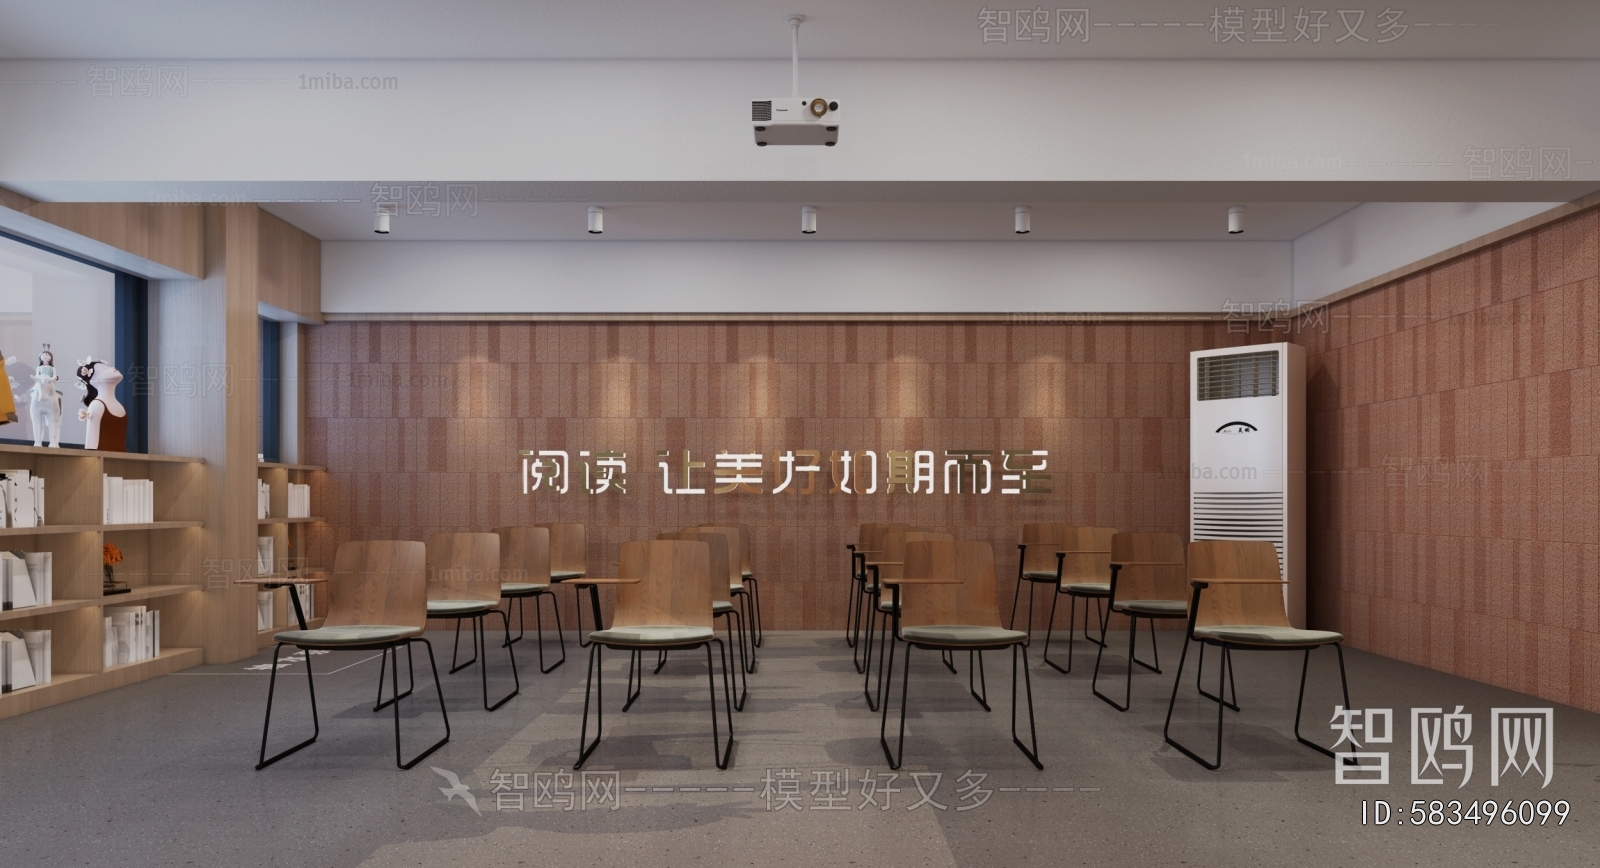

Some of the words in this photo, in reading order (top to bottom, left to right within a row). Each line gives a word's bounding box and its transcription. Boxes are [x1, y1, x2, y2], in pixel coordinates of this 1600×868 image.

[519, 449, 627, 494] 阅读
[657, 449, 1052, 495] 让美好如期而至
